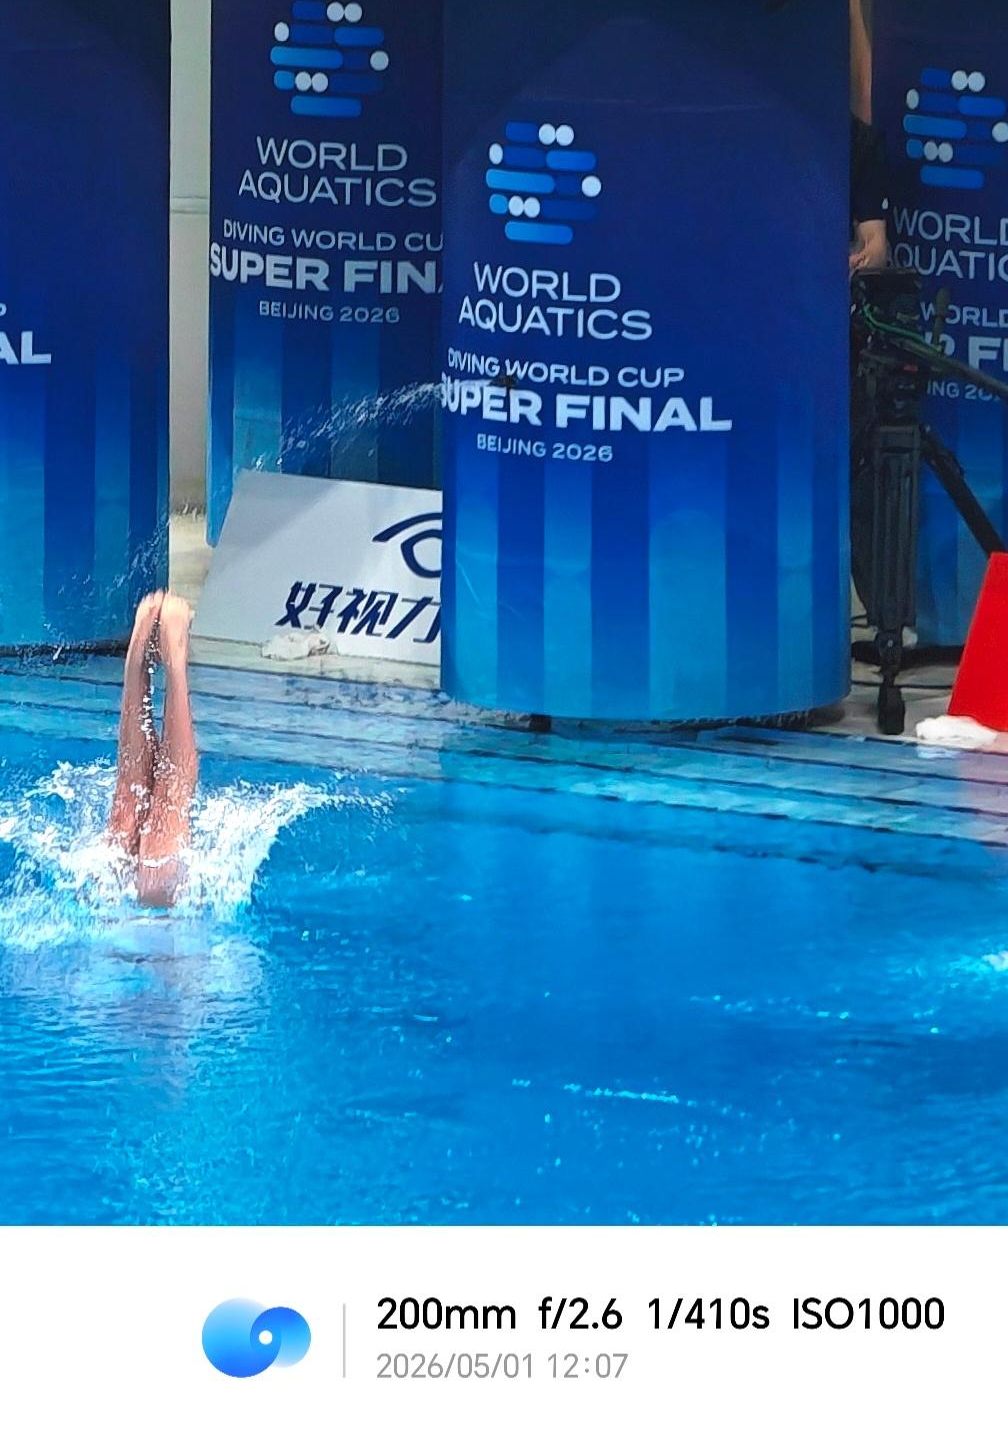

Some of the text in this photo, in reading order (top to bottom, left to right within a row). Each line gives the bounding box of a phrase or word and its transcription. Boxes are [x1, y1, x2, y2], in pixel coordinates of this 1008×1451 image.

[256, 135, 407, 172] WORLD
[238, 169, 437, 208] AQUATICS
[224, 218, 285, 246] DIVING
[292, 228, 396, 252] WORLD
[210, 242, 443, 294] SUPER FIN
[473, 261, 621, 303] WORLD
[259, 300, 400, 324] BEIJING 2026
[458, 295, 653, 341] AQUATICS
[448, 347, 685, 388] DIVING WORLD CUP
[555, 393, 733, 433] FINAL
[477, 433, 613, 462] BEIJING 2026
[274, 580, 442, 644] 好视力
